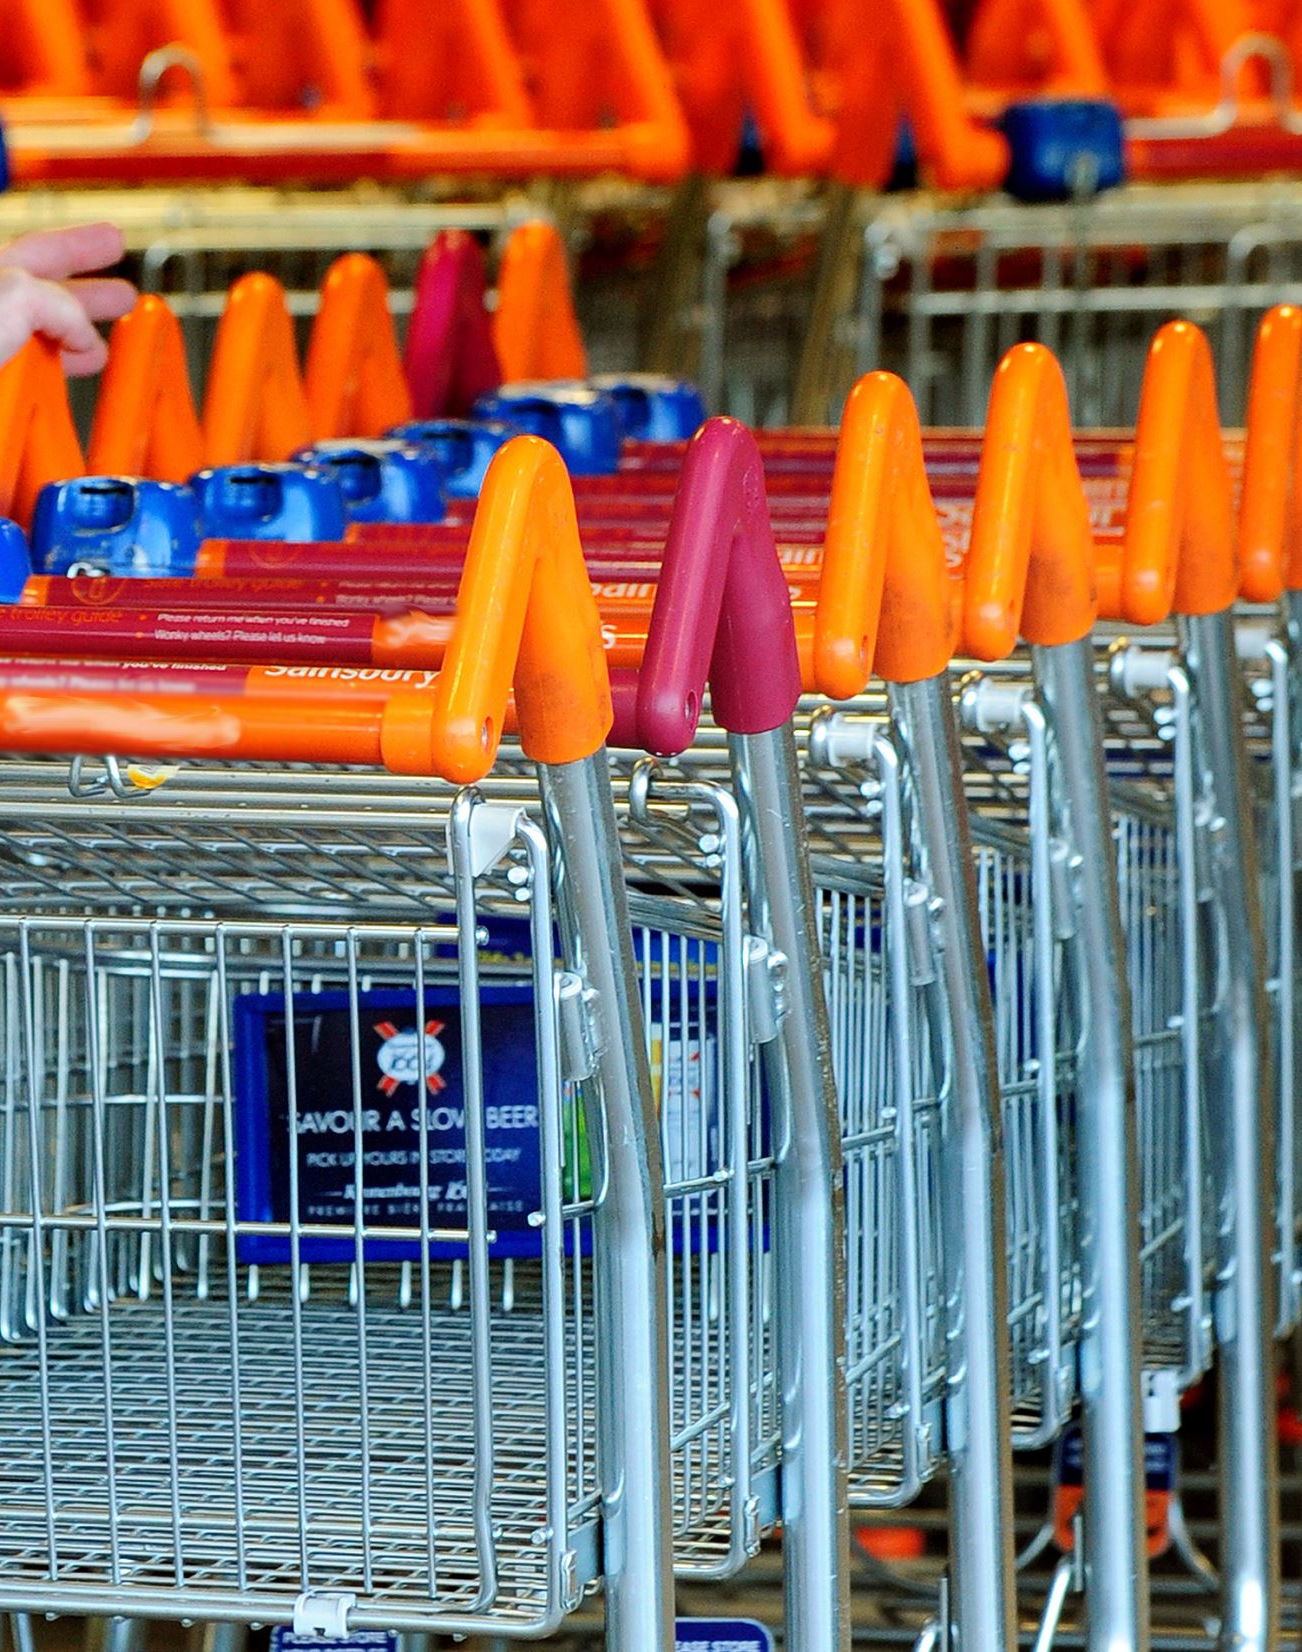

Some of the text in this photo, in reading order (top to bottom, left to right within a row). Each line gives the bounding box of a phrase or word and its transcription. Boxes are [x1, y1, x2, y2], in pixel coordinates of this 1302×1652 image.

[193, 614, 225, 623] return
[227, 615, 244, 623] me
[245, 615, 274, 624] when
[309, 617, 350, 628] finished
[155, 629, 189, 642] Wonky
[190, 630, 232, 641] wheels?
[233, 630, 267, 642] Please
[385, 1110, 406, 1132] A
[485, 1104, 538, 1130] BEER
